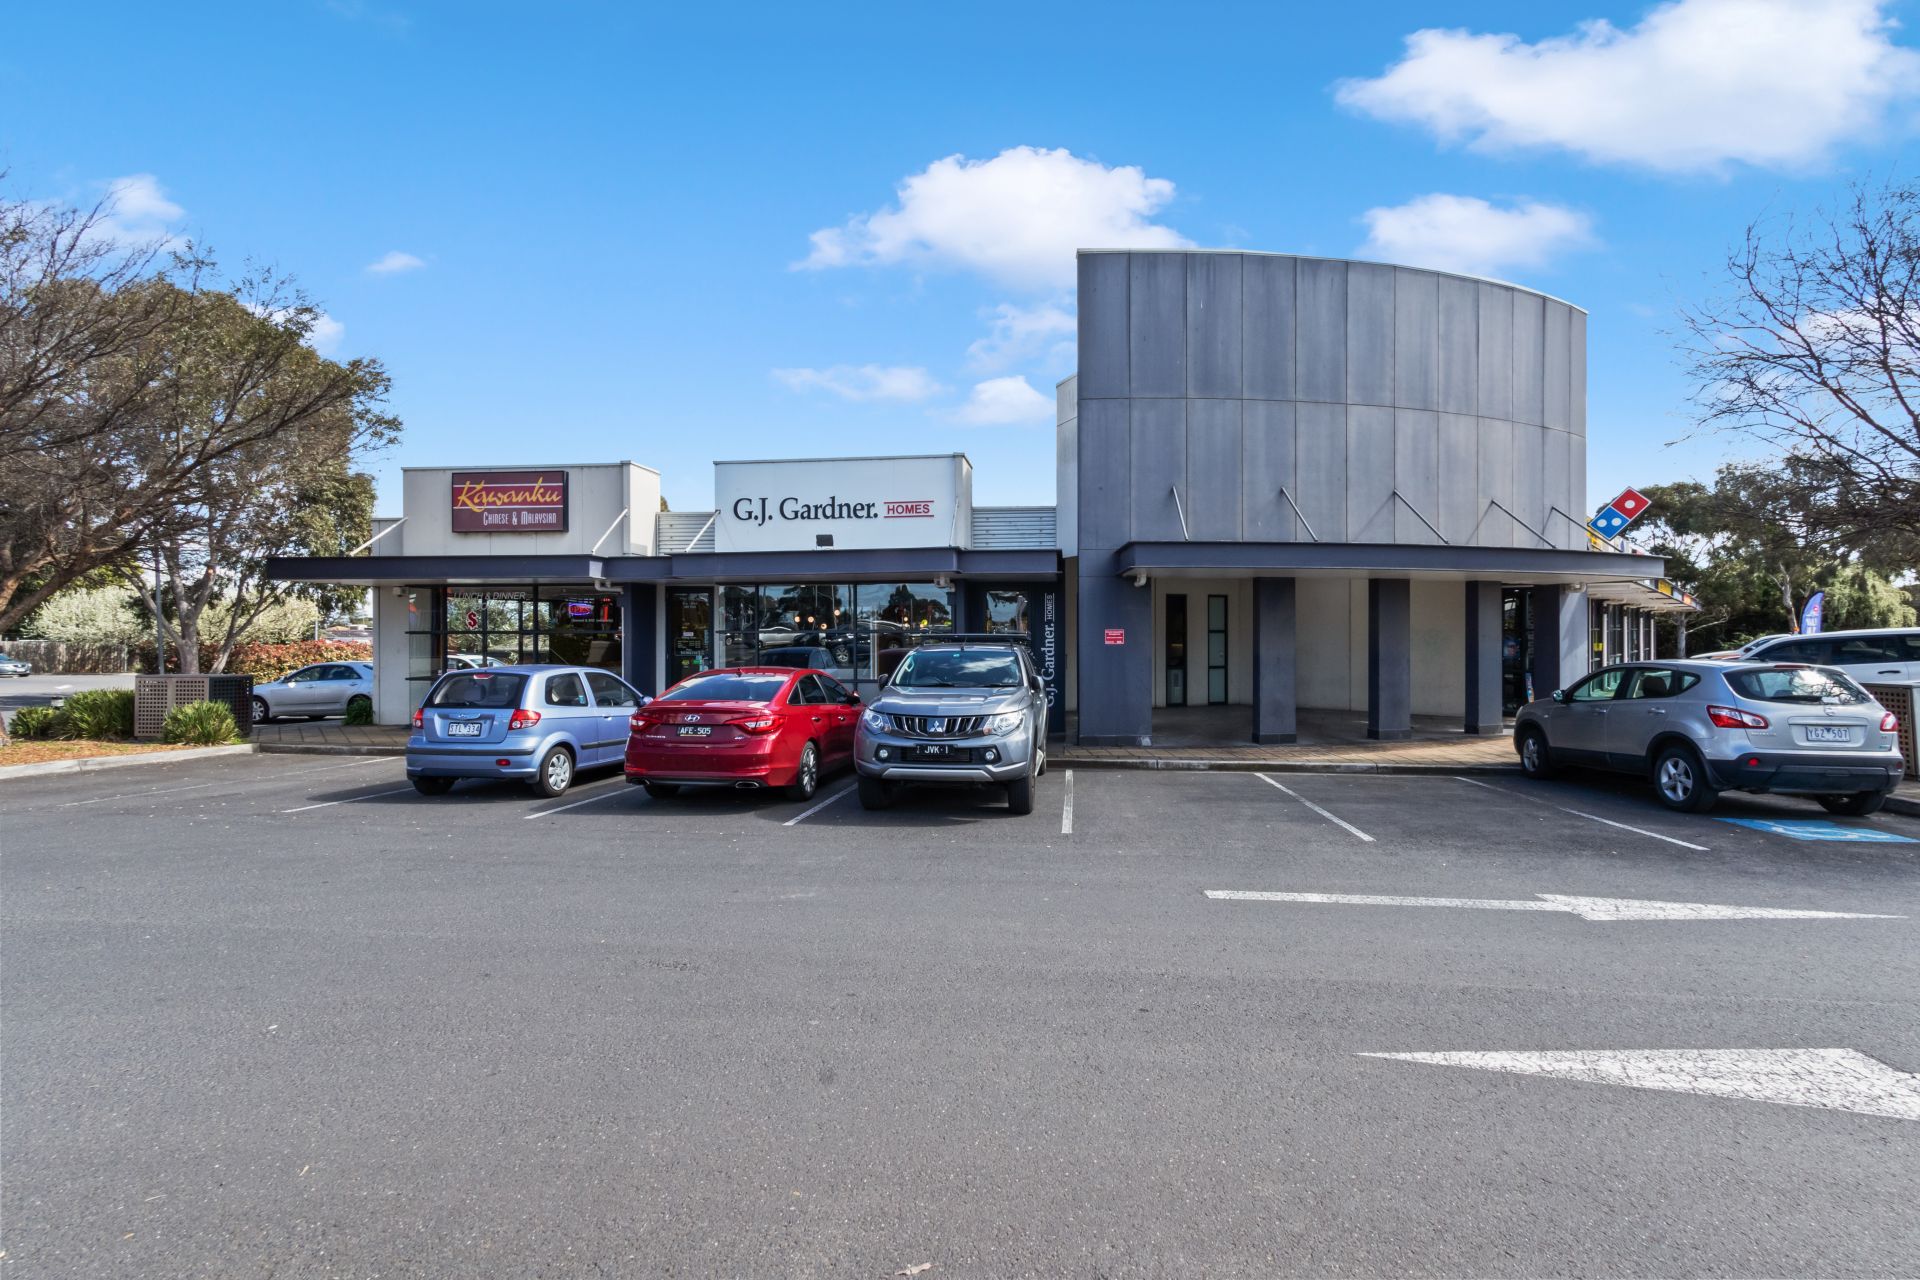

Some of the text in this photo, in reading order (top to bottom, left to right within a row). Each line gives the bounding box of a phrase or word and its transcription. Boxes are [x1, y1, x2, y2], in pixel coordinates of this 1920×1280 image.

[456, 476, 562, 512] Kawanku
[512, 511, 518, 526] &
[733, 496, 930, 526] G.J. Gardner. HOMES
[453, 591, 526, 600] LUNCH & DINNER
[1041, 622, 1055, 681] Gardner.
